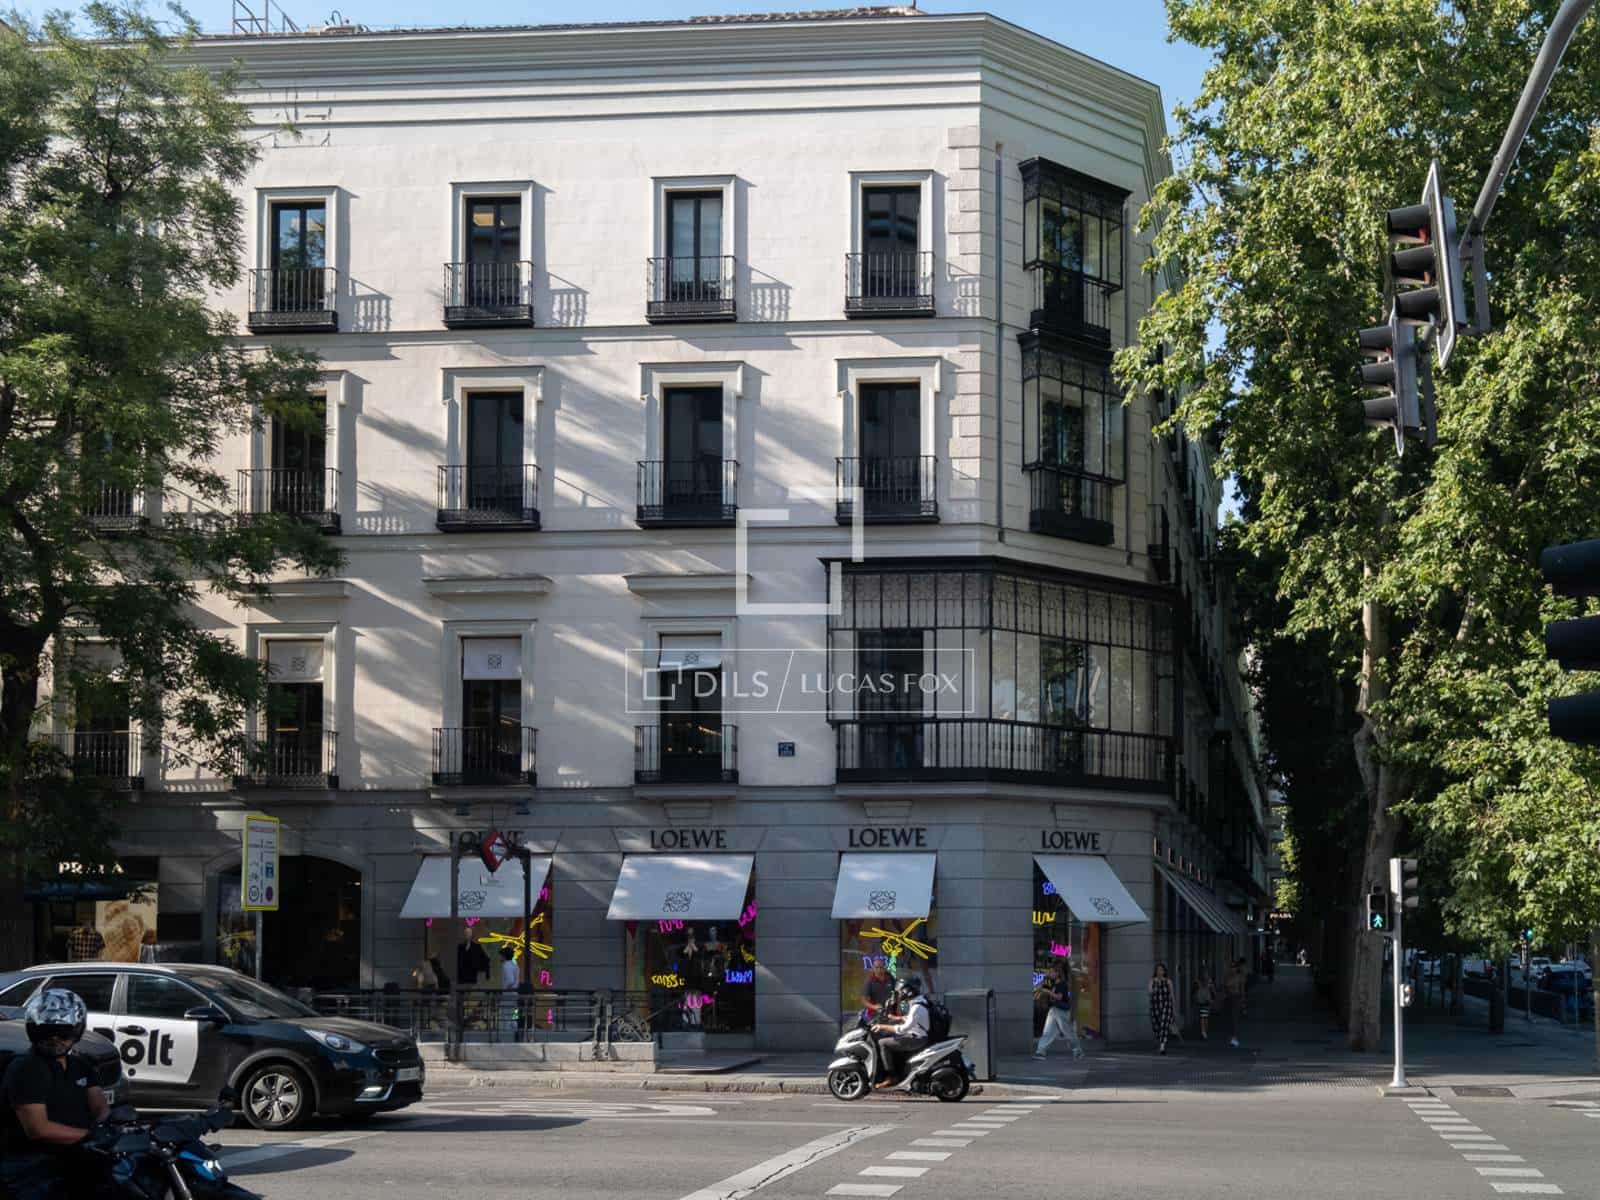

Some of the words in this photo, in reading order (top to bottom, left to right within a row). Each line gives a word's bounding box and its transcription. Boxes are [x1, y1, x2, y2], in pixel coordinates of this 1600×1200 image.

[650, 829, 728, 849] LOEWE
[849, 827, 928, 848] LOEWE
[1041, 830, 1101, 850] LOEWE
